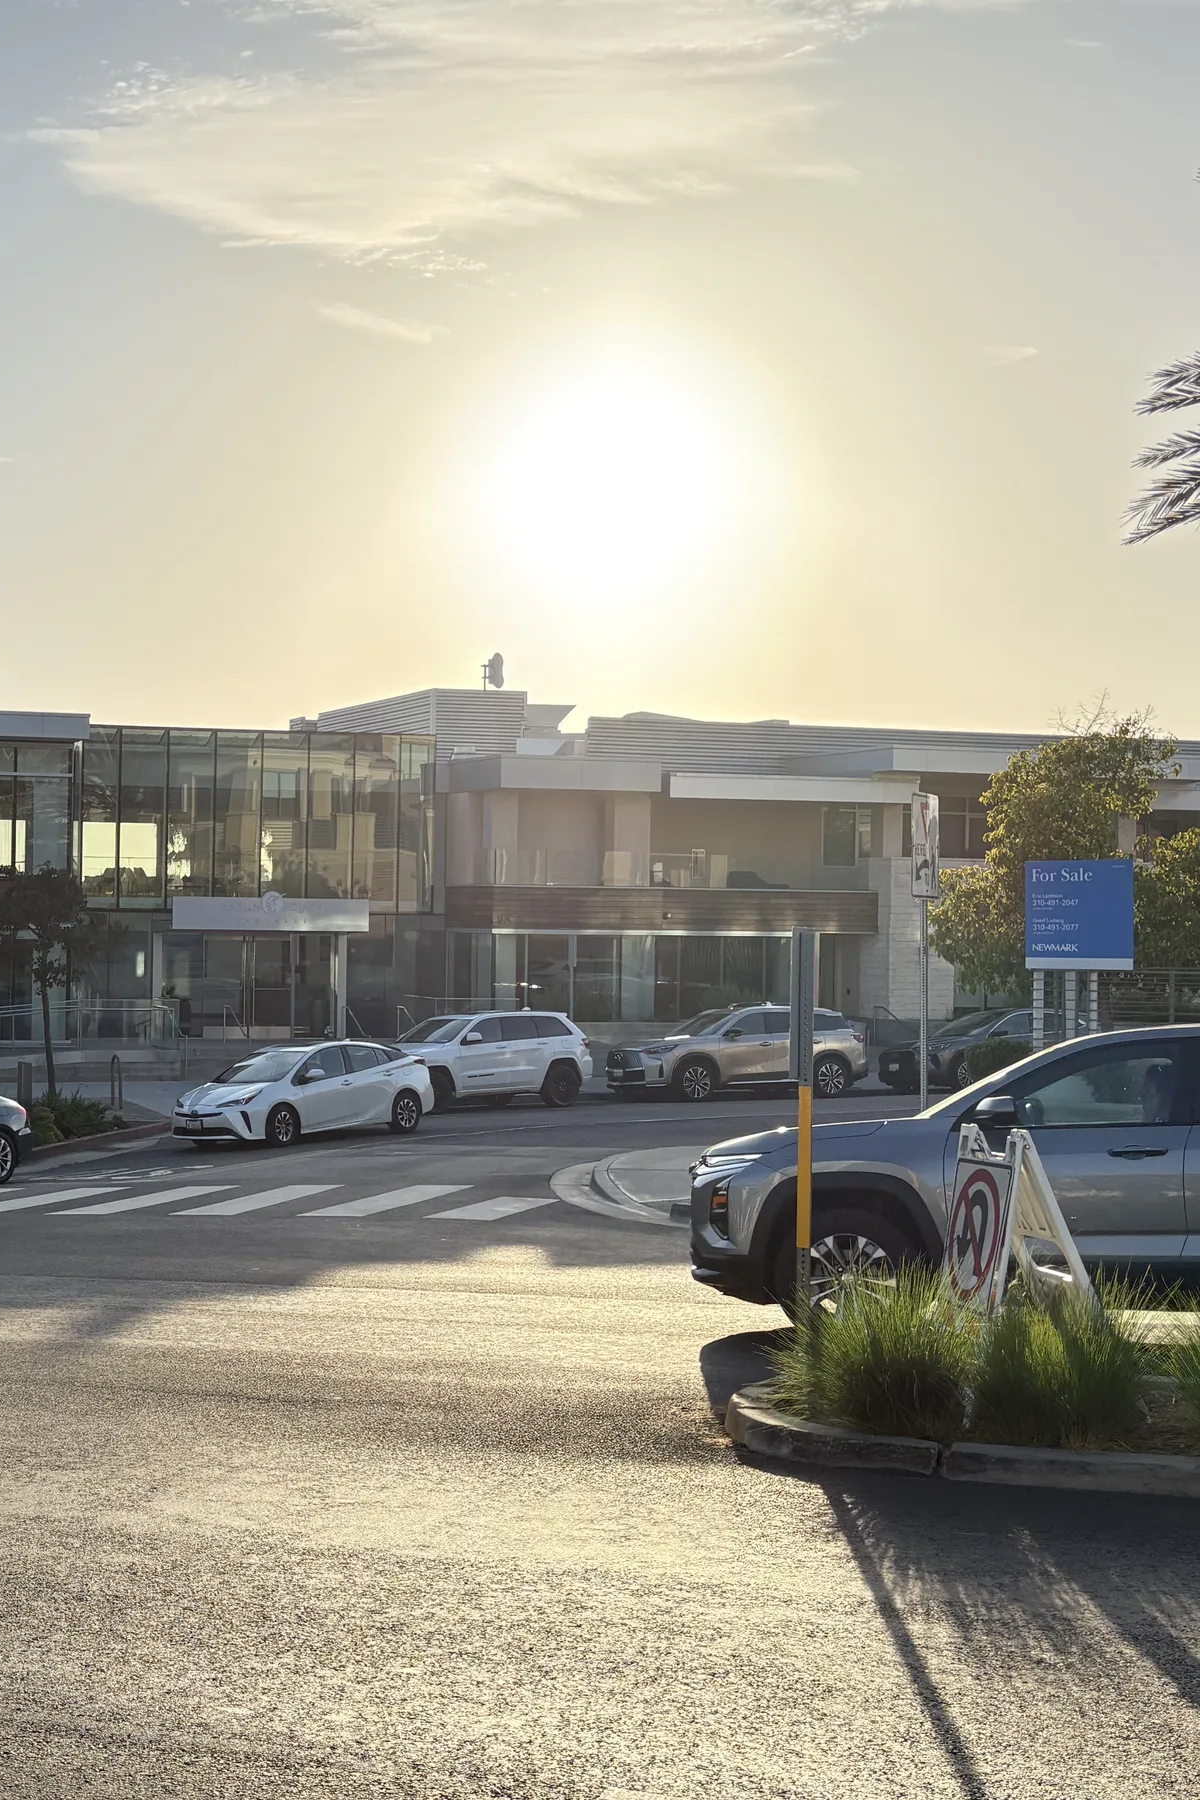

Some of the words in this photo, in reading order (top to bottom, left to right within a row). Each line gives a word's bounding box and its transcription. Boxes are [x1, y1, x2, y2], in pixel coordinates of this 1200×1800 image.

[1032, 868, 1057, 882] For
[1061, 868, 1093, 881] Sale
[1032, 899, 1079, 907] 310-491-2047
[1032, 923, 1079, 931] 310-491-2077
[1032, 943, 1078, 952] NEWMARK
